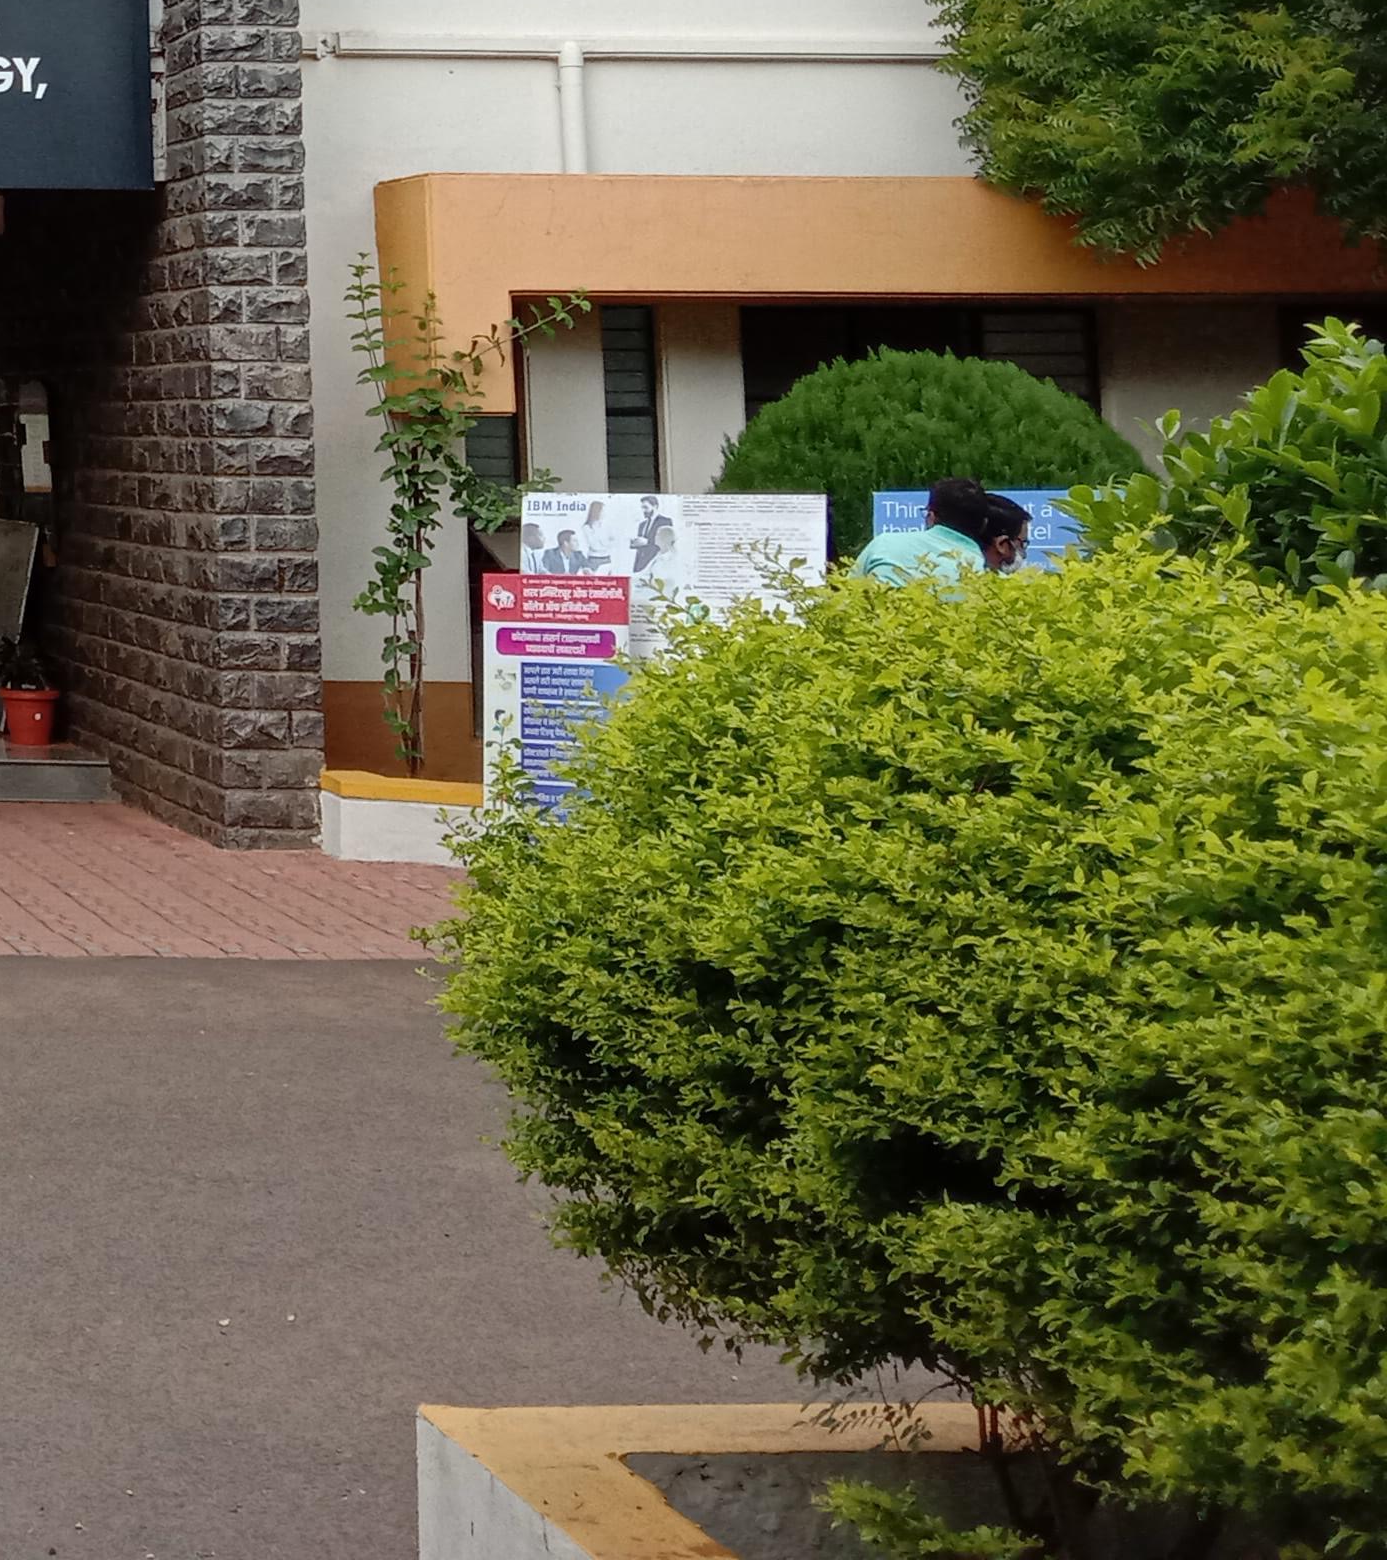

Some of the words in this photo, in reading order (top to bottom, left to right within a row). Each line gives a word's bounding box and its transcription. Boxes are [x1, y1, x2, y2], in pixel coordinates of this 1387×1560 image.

[527, 500, 552, 511] IBM
[556, 500, 587, 512] India
[882, 501, 927, 518] Thin
